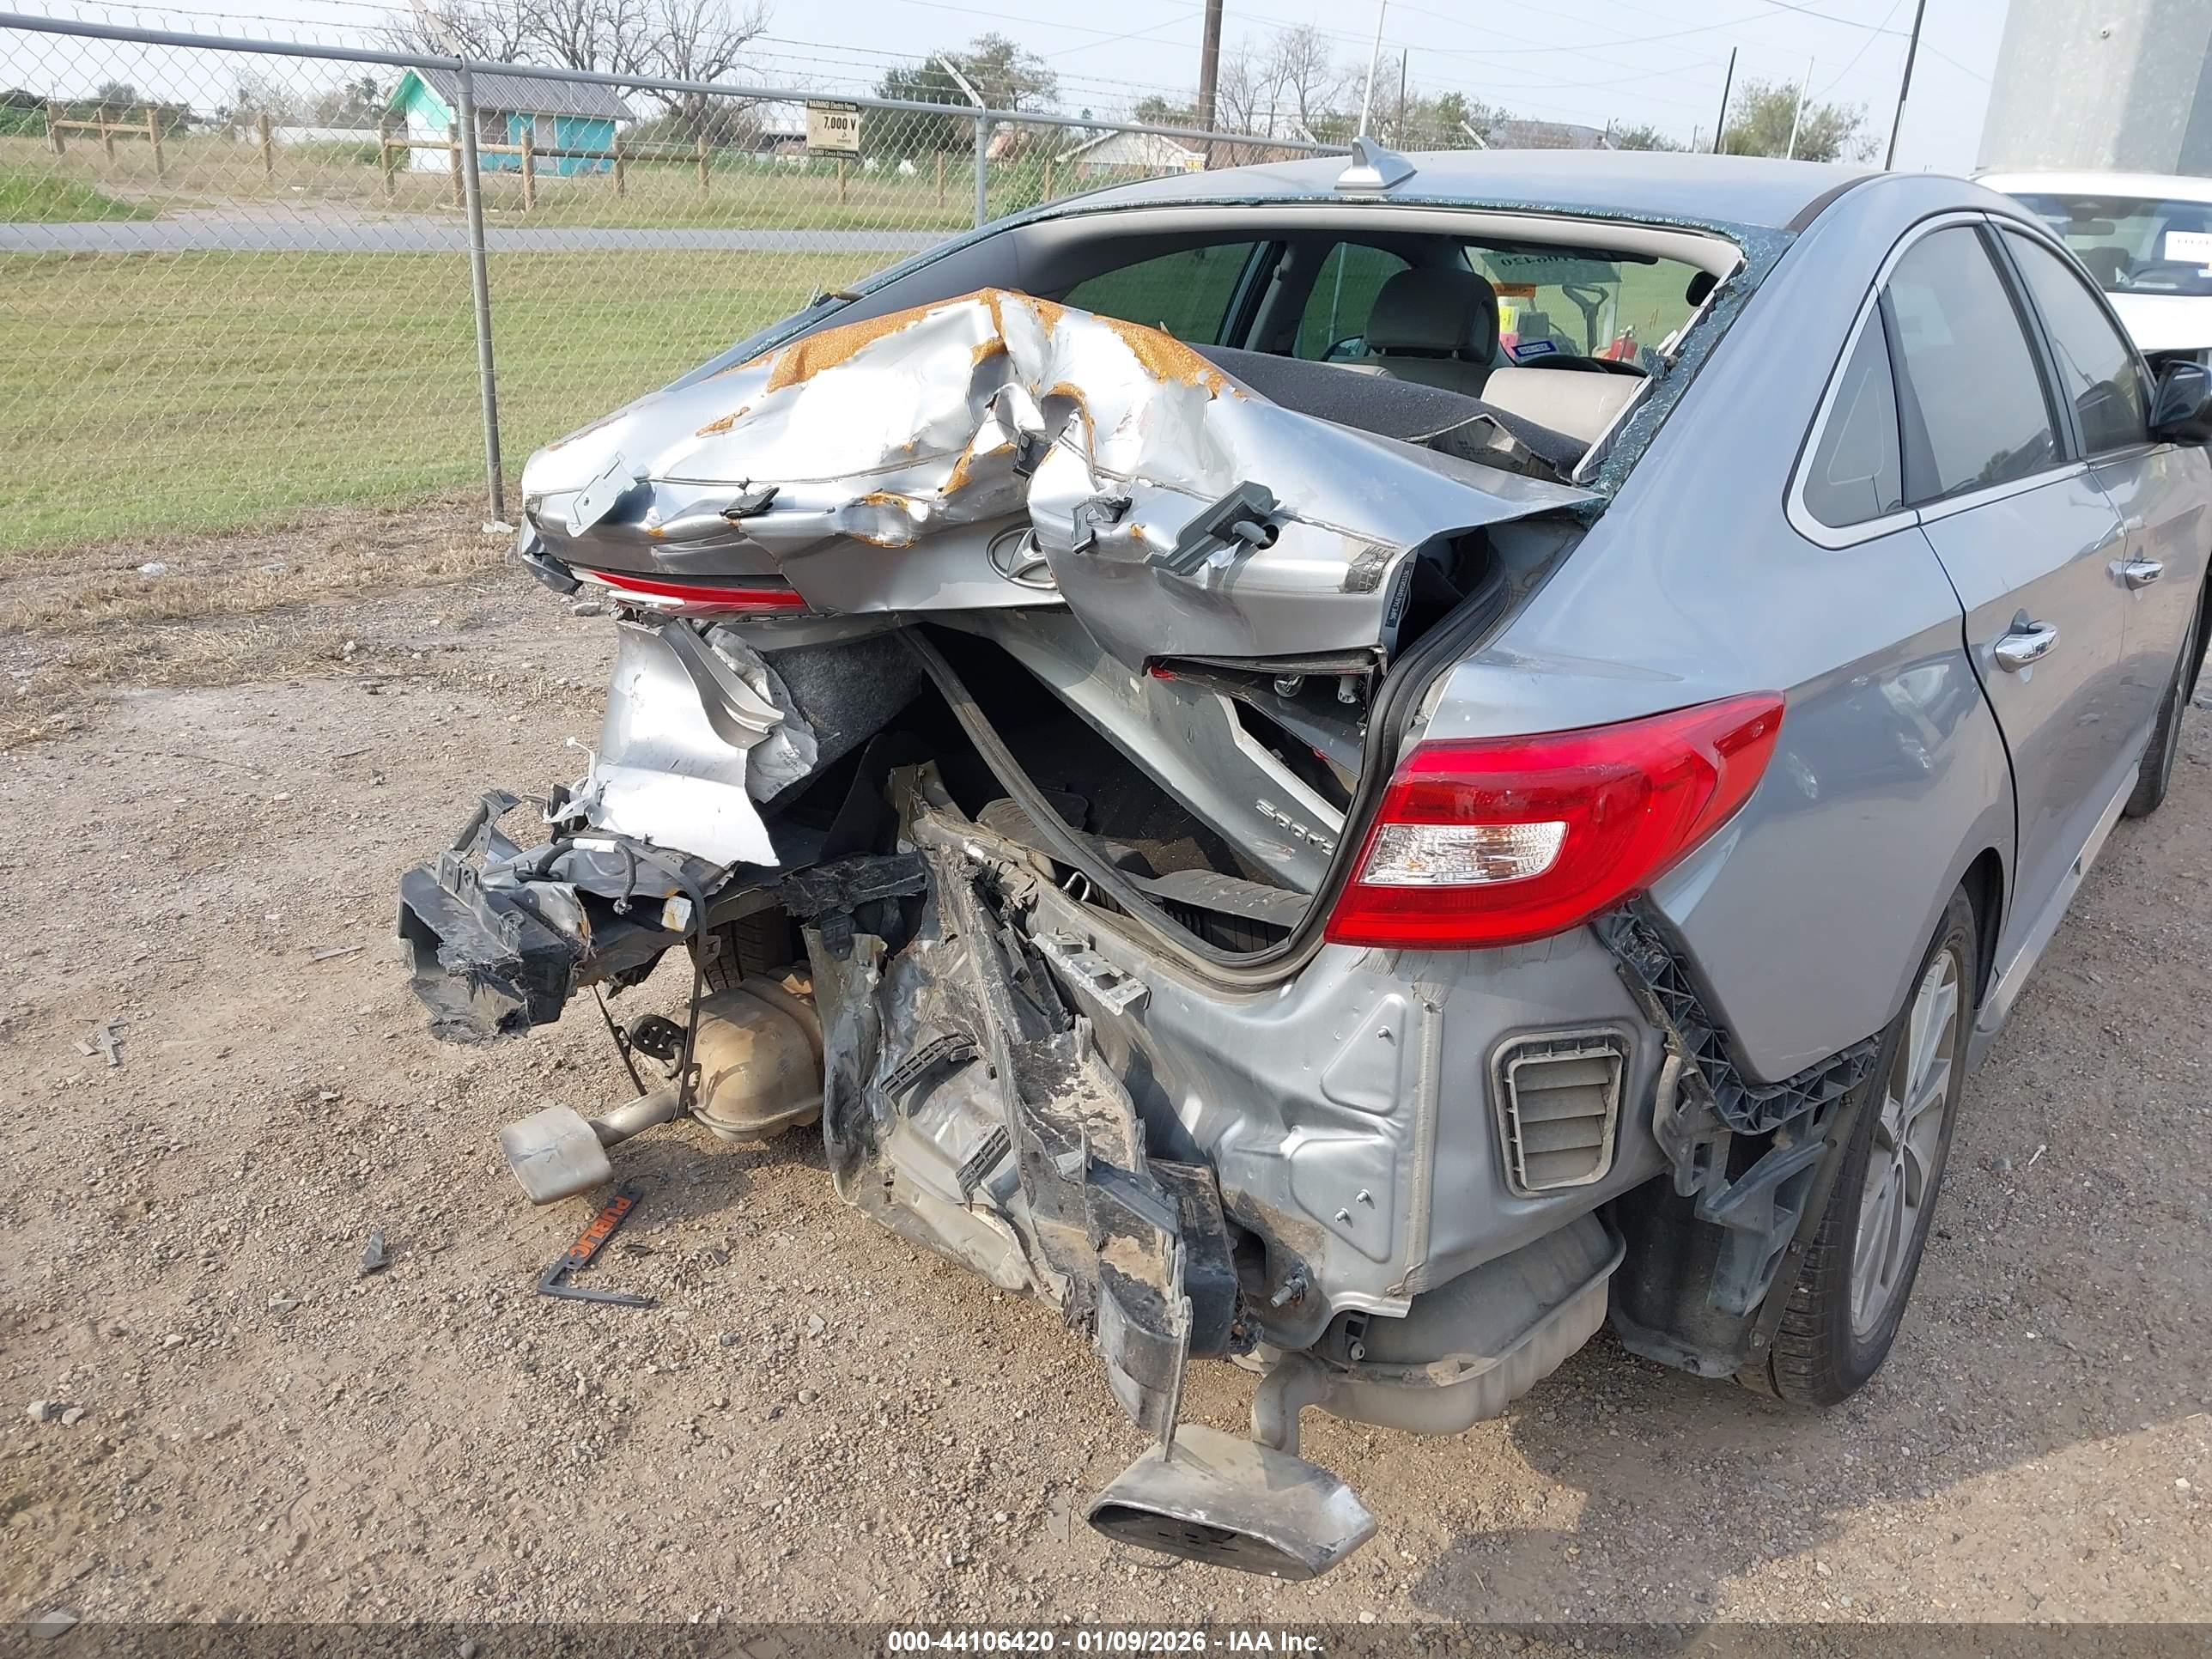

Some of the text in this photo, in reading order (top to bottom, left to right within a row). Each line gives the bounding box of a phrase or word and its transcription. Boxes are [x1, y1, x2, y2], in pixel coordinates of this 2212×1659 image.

[824, 116, 857, 131] 7,000 V
[568, 1195, 634, 1259] PUBLIC
